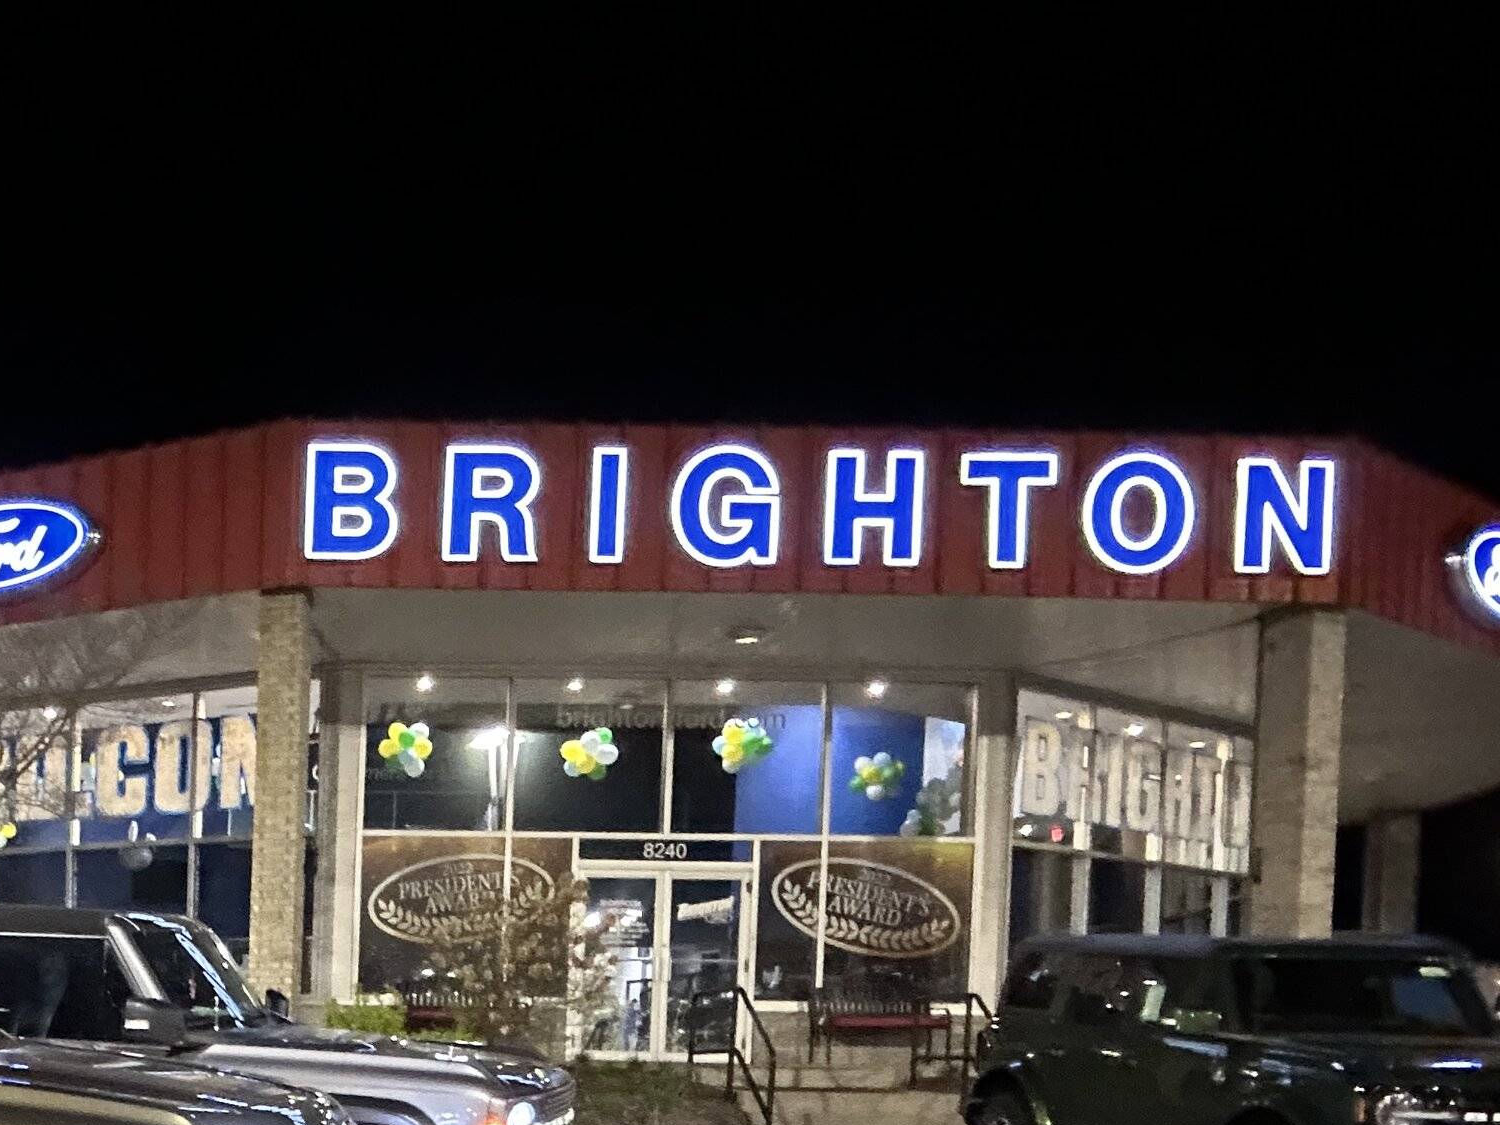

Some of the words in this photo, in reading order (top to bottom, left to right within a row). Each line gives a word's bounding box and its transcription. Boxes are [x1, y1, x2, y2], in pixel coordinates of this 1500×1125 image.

[303, 443, 1336, 576] BRIGHTON
[642, 842, 688, 859] 8240
[827, 895, 903, 927] AWARD
